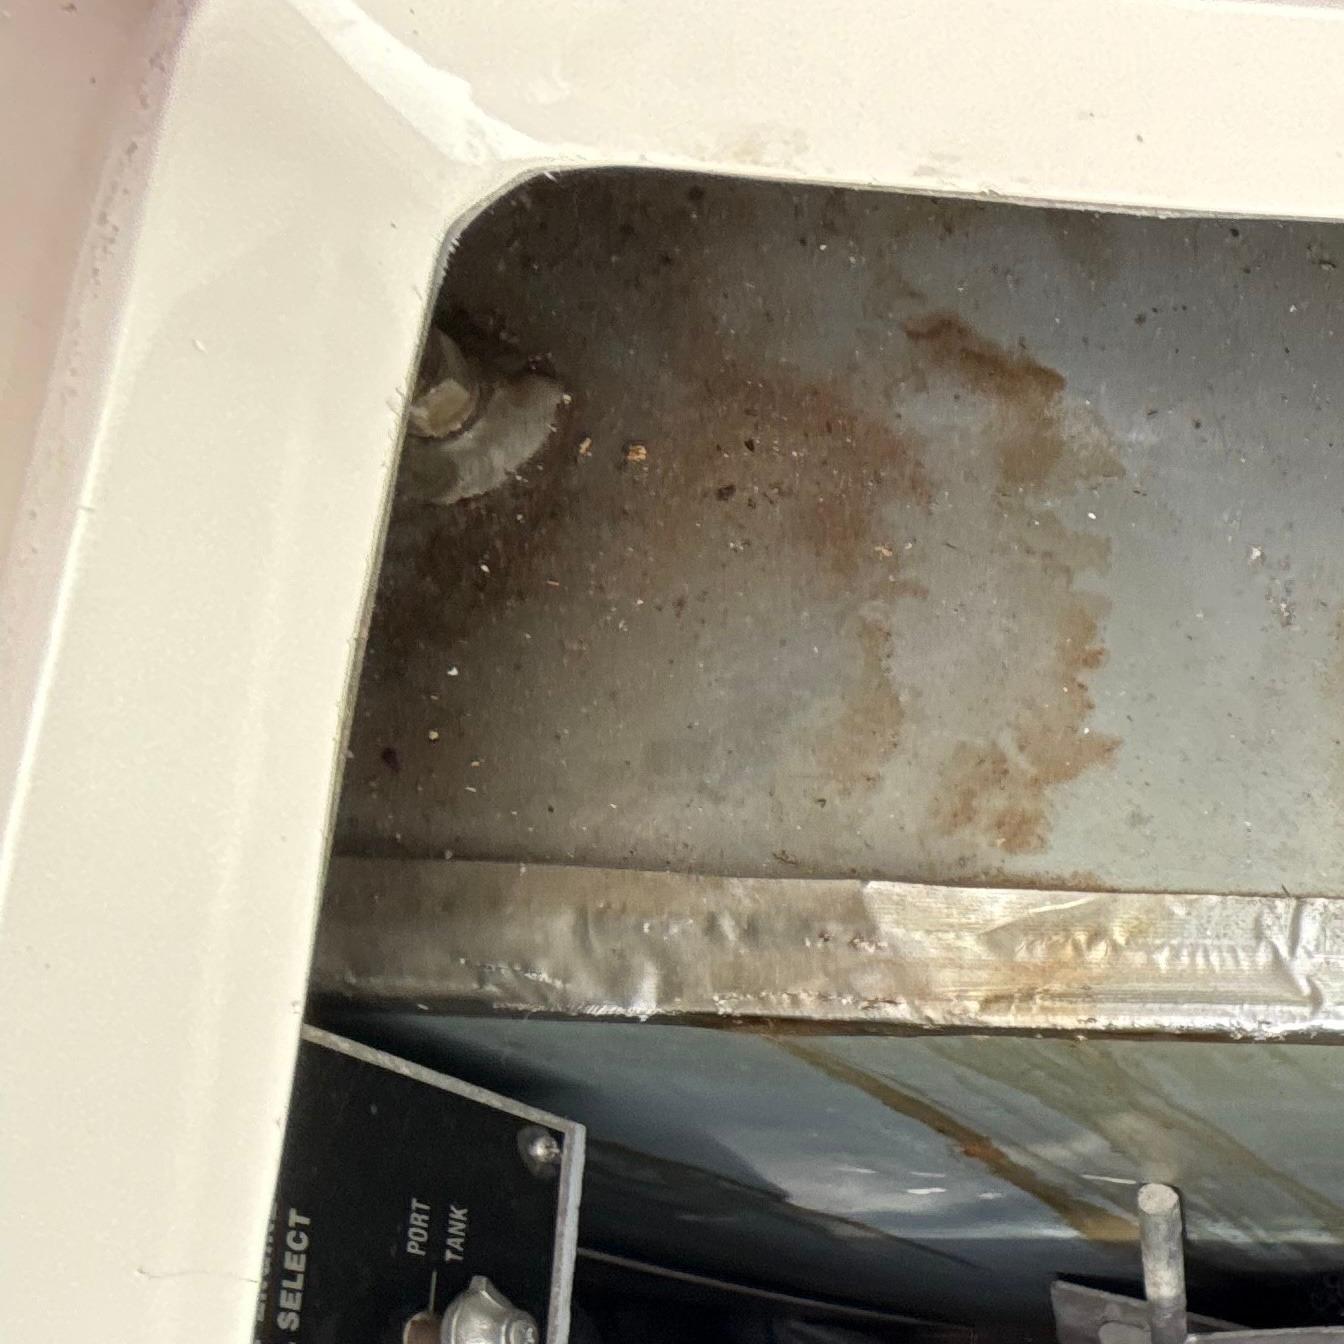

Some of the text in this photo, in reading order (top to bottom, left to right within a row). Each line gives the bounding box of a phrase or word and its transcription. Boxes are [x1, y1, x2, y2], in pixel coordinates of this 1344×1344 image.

[406, 1198, 431, 1257] PORT
[445, 1204, 469, 1263] TANK
[276, 1207, 311, 1332] SELECT
